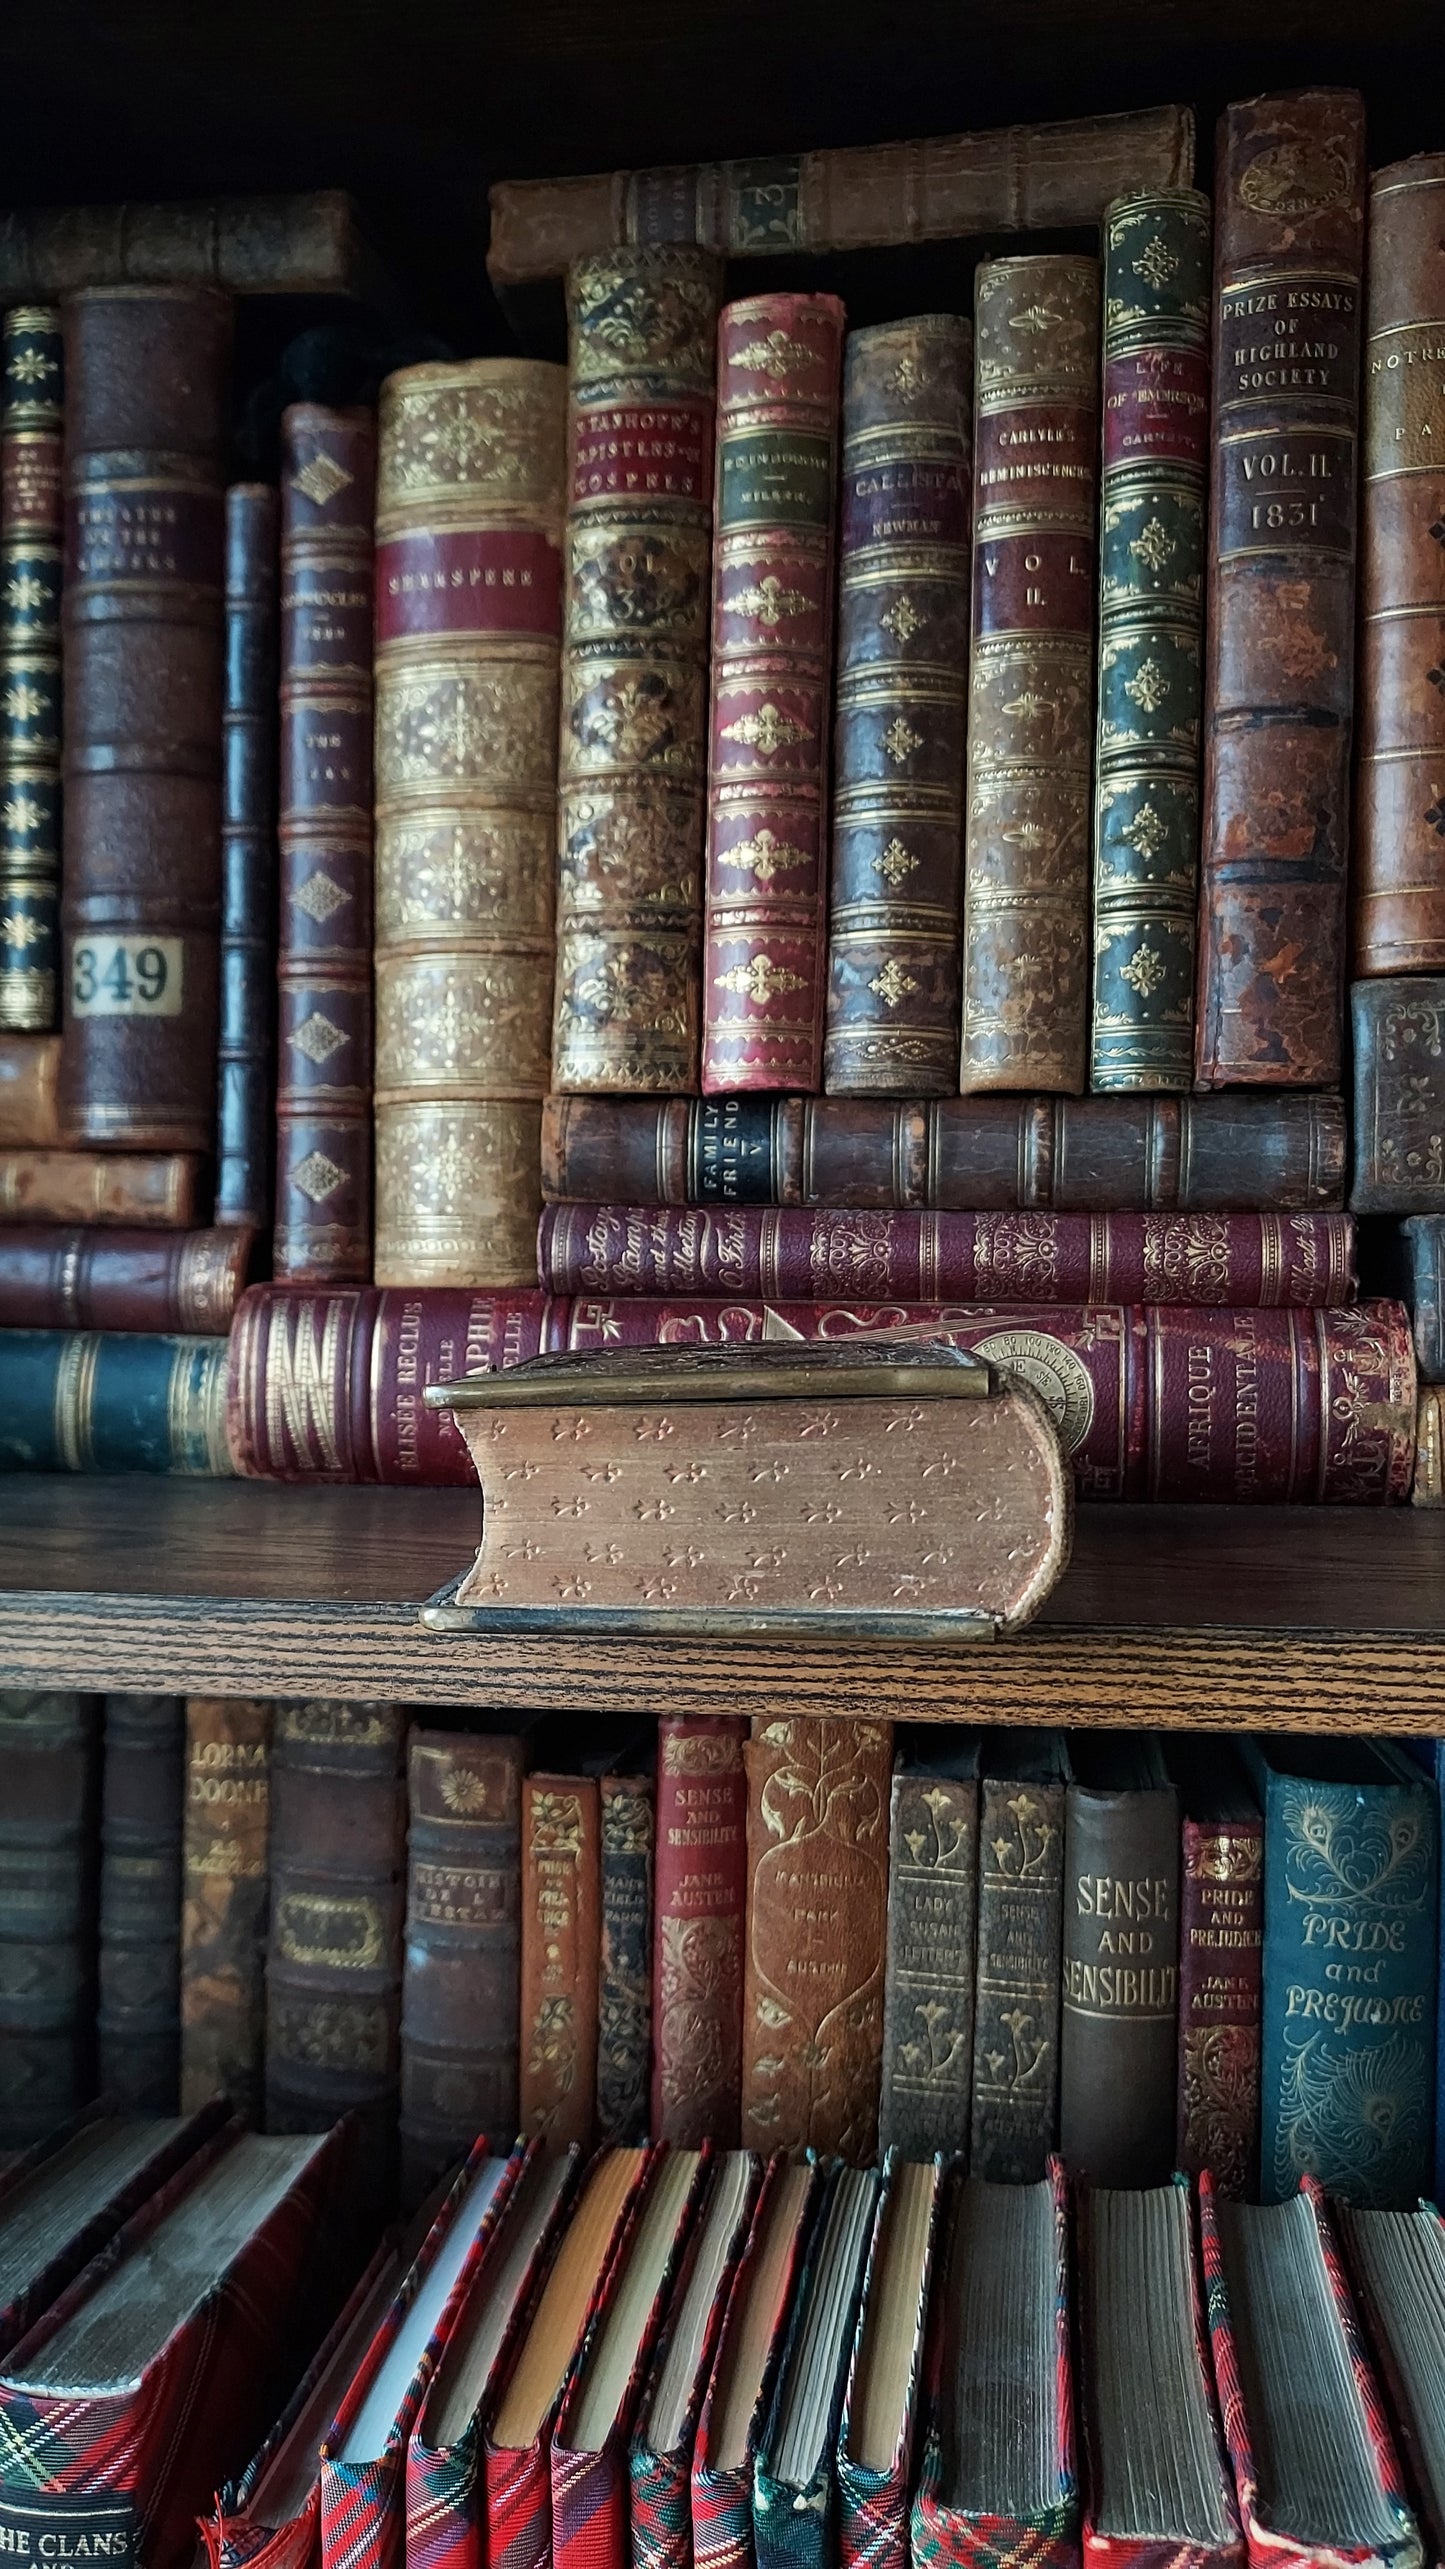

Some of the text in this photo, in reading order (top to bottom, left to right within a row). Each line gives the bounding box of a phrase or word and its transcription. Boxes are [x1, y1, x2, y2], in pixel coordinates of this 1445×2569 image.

[1223, 292, 1353, 320] PRIZE ESSAYS
[1274, 319, 1299, 336] OF
[1234, 342, 1339, 367] HIGHLAND
[1238, 369, 1330, 391] SOCIETY
[1107, 392, 1127, 409] OF
[999, 424, 1076, 446] CARLYLE'S
[855, 473, 962, 498] CALLISTA
[1253, 502, 1317, 529] 1831
[872, 519, 941, 537] NEWMAN
[75, 946, 168, 1003] 349
[704, 1105, 719, 1189] FAMILY
[723, 1101, 739, 1196] FRIEND
[396, 1302, 423, 1384] RECLUS
[1003, 1336, 1017, 1346] 80
[1025, 1336, 1042, 1347] 100
[1045, 1342, 1062, 1356] 120
[1062, 1355, 1077, 1370] 140
[1074, 1373, 1087, 1391] 160
[1187, 1345, 1216, 1471] AFRIQUE
[189, 1742, 266, 1768] LORNA
[189, 1777, 268, 1805] DOONE
[674, 1788, 734, 1806] SENSE
[686, 1811, 720, 1824] AND
[667, 1826, 737, 1847] SENSIBILITY
[679, 1873, 723, 1888] JANE
[669, 1888, 735, 1907] AUSTEN
[915, 1896, 954, 1912] LADY
[1076, 1873, 1169, 1922] SENSE
[1201, 1889, 1255, 1907] PRIDE
[794, 1908, 839, 1922] PARK
[1001, 1904, 1039, 1920] SENSE
[1211, 1911, 1244, 1927] AND
[1098, 1930, 1154, 1955] AND
[1190, 1928, 1263, 1949] PREJUDICE
[1301, 1913, 1406, 1952] PRIDE
[1325, 1959, 1387, 1983] and
[1201, 1976, 1249, 1990] JANE
[1192, 1993, 1260, 2010] AUSTEN
[1285, 1984, 1425, 2036] PREJUDICE
[38, 2531, 128, 2557] CLANS
